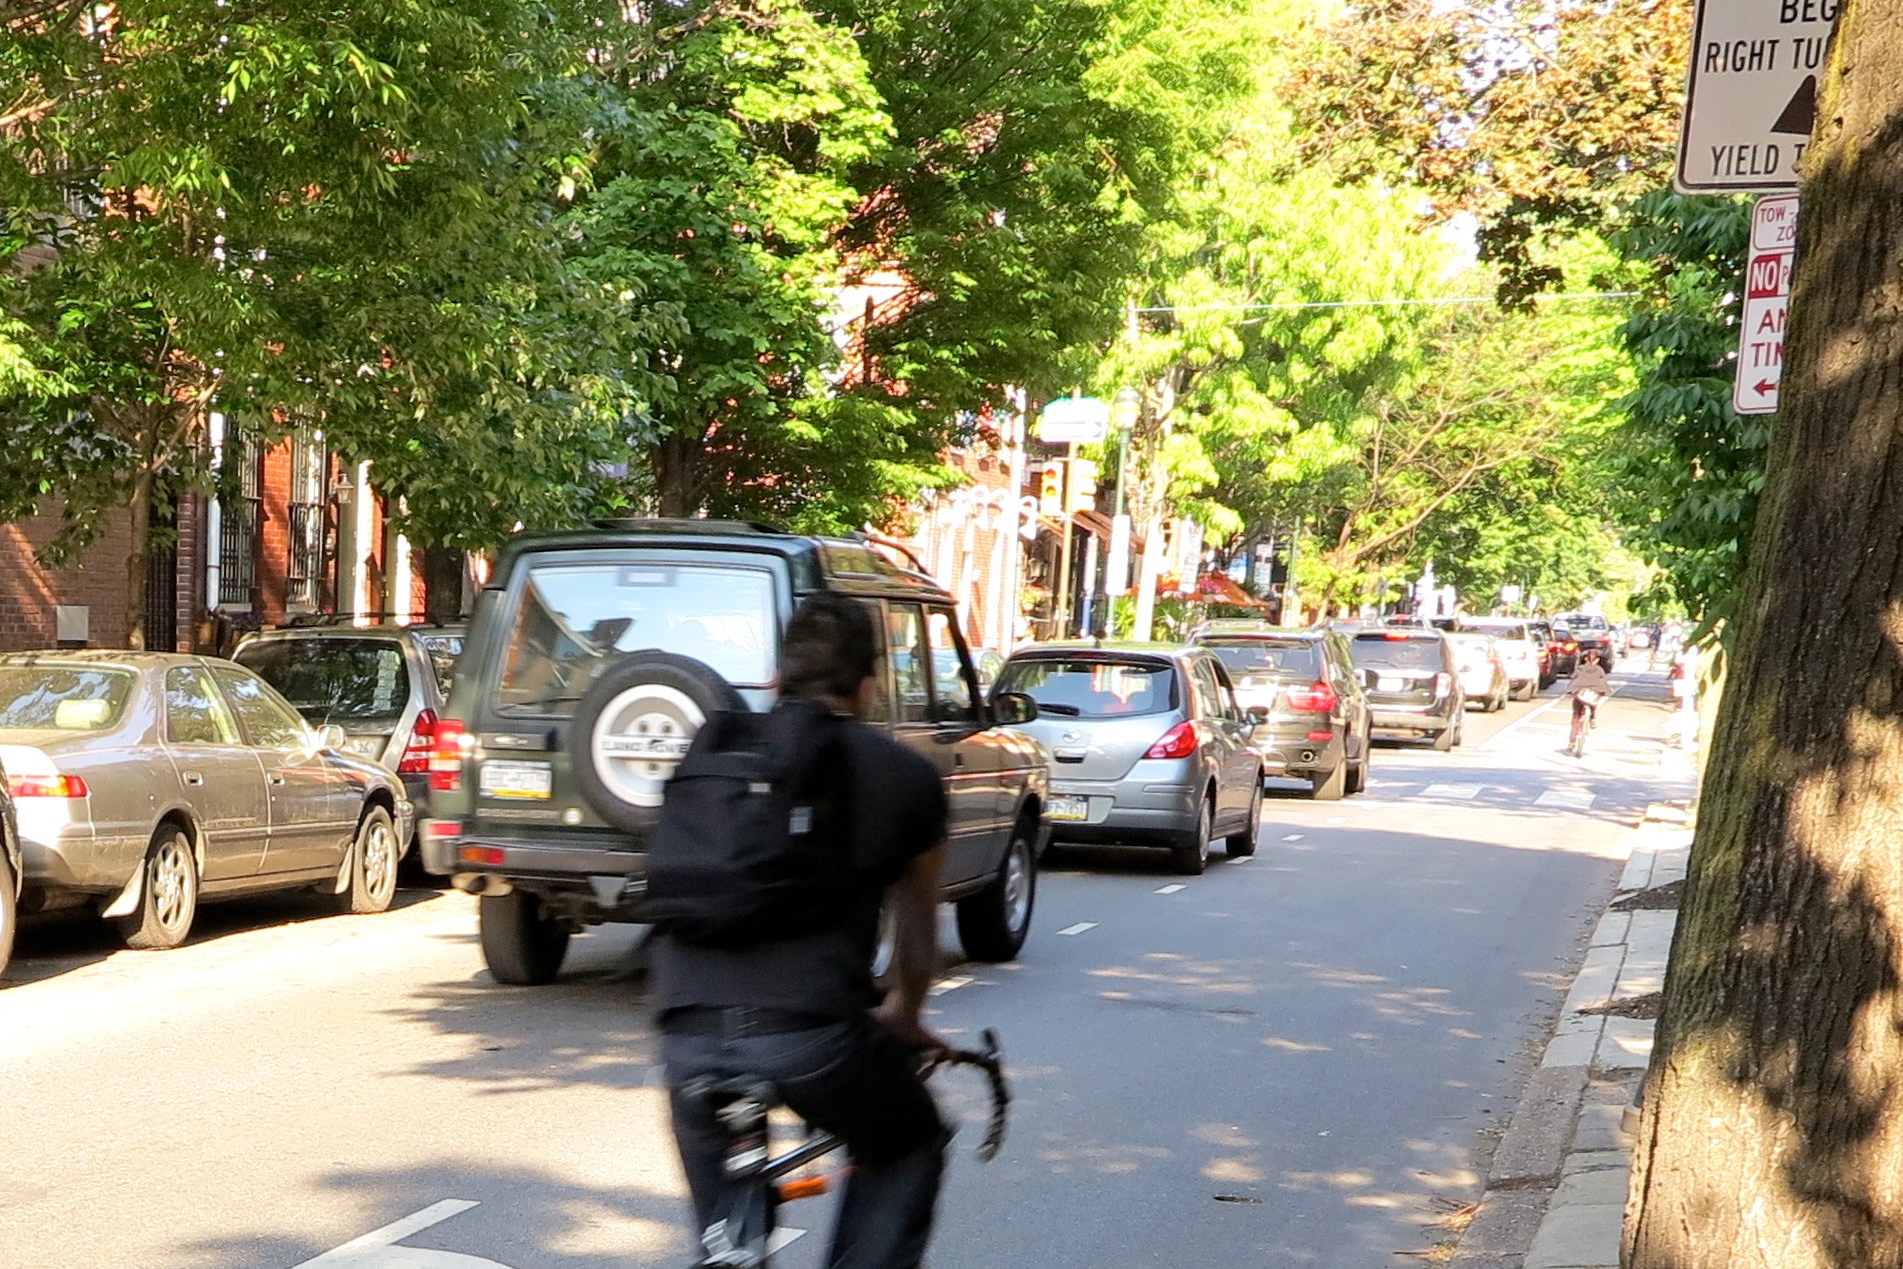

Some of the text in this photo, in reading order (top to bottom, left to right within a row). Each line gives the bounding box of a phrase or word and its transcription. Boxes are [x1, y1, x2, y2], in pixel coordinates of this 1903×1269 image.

[1780, 0, 1837, 24] BEG
[1704, 37, 1823, 74] RIGHT TU
[1711, 143, 1780, 177] YIELD
[1776, 225, 1796, 243] ZO
[1751, 260, 1779, 293] NO
